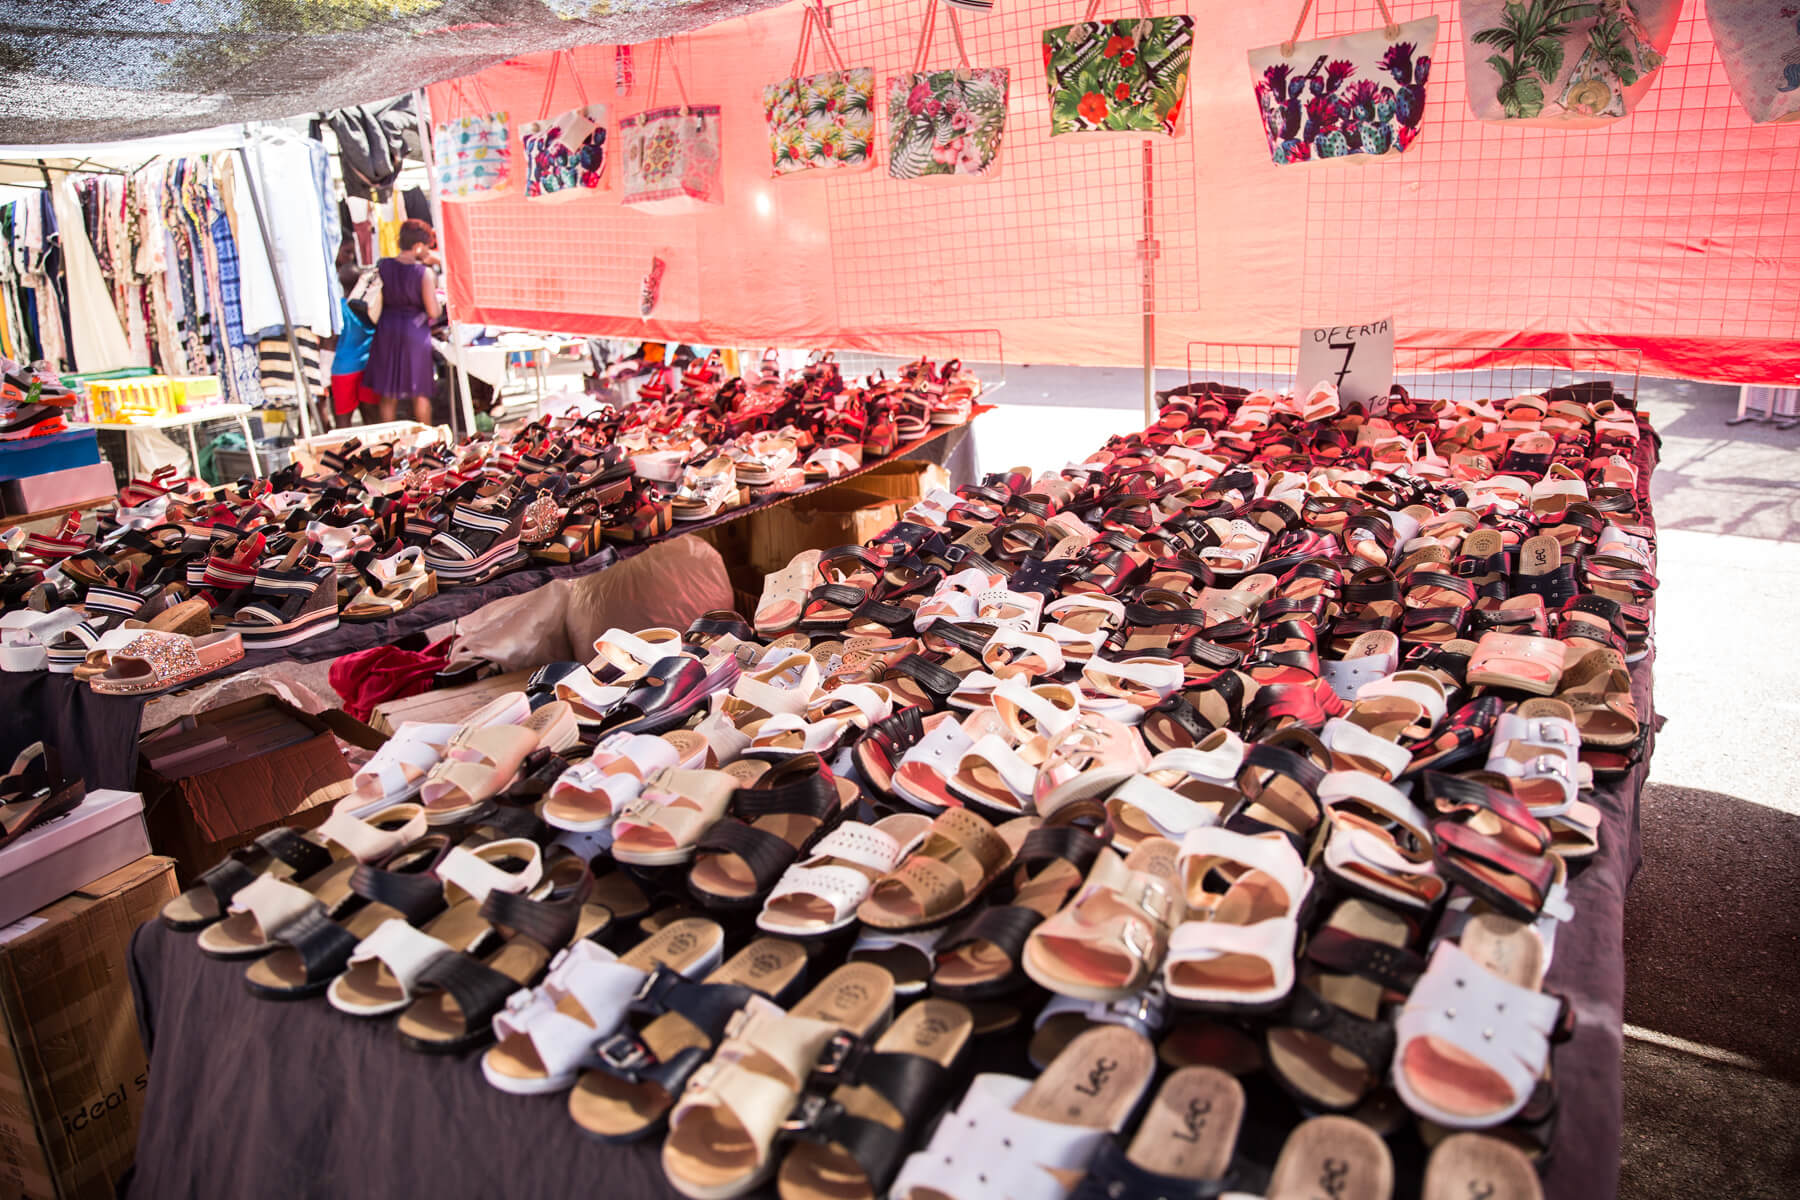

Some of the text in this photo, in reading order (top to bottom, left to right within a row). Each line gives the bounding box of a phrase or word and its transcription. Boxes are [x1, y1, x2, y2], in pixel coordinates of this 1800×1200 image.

[1313, 320, 1388, 345] OFERTA
[1329, 342, 1356, 388] 7
[63, 1064, 150, 1136] ideal s
